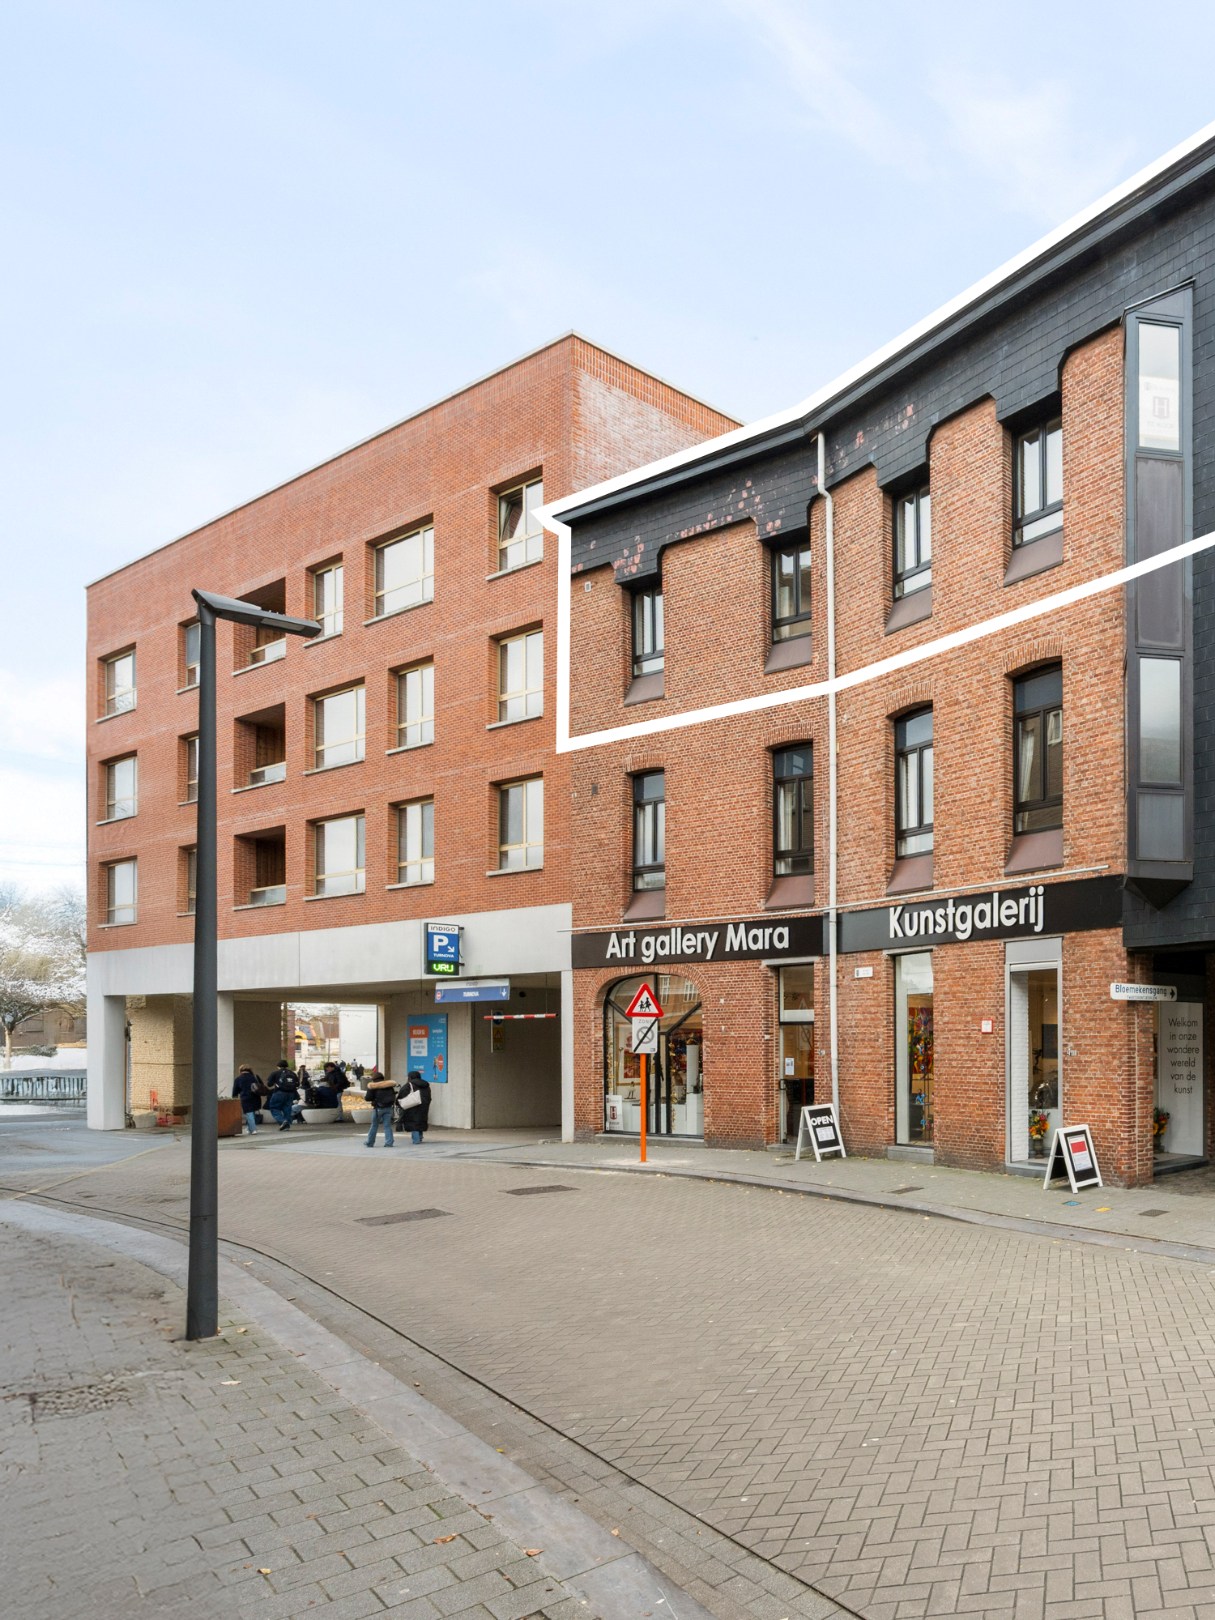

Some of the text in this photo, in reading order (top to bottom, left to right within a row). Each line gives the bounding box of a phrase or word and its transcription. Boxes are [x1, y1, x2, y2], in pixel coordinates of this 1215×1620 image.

[889, 885, 1045, 940] Kunstgalerij
[433, 934, 449, 952] P
[605, 923, 789, 963] Art gallery Mara
[1115, 984, 1167, 997] Bloemekensgang
[1168, 1018, 1198, 1027] Welkom
[1178, 1033, 1197, 1041] onze
[1167, 1045, 1199, 1054] wondere
[1170, 1058, 1196, 1067] wereld
[1170, 1071, 1196, 1081] van de
[1174, 1084, 1193, 1094] kunst
[811, 1115, 834, 1126] OPEN
